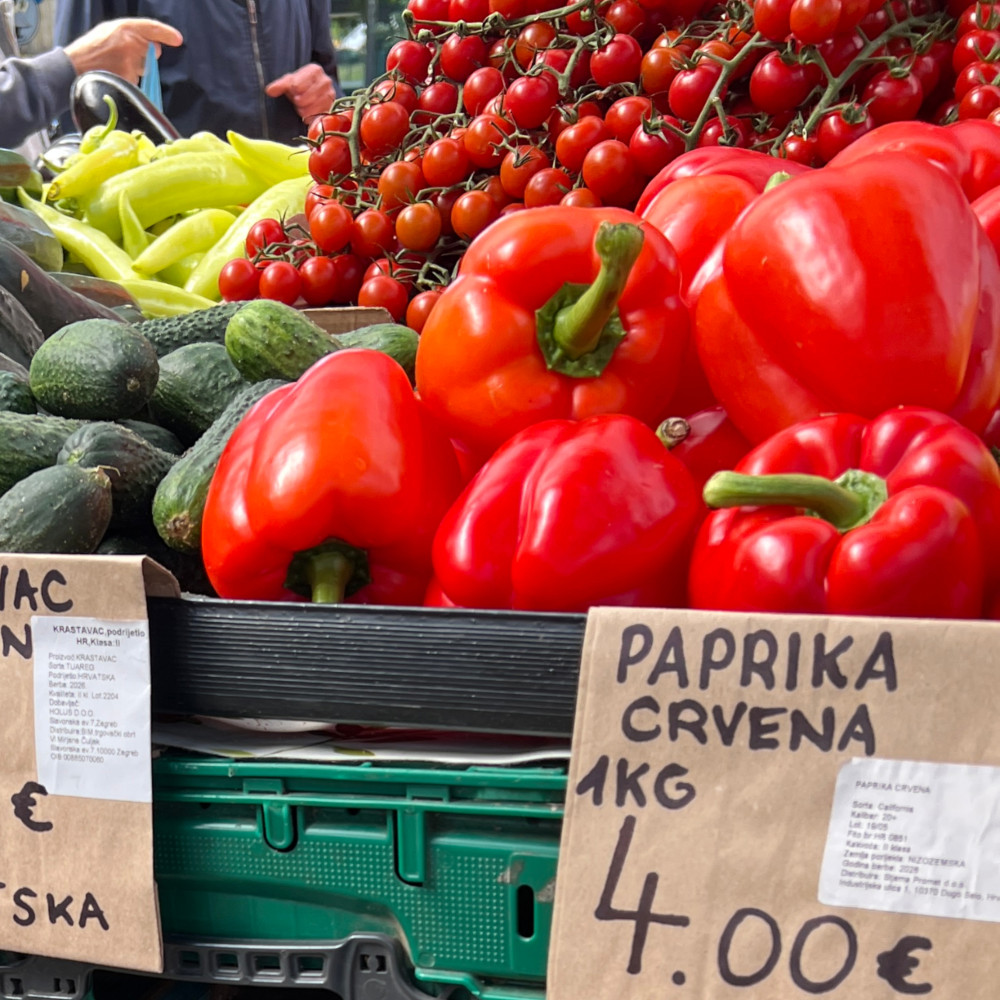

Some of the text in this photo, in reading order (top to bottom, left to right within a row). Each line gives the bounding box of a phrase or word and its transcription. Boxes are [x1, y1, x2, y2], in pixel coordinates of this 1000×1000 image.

[616, 624, 899, 691] PAPRIKA
[622, 696, 876, 756] CRVENA
[576, 755, 697, 809] 1KG
[594, 814, 858, 994] 4.00
